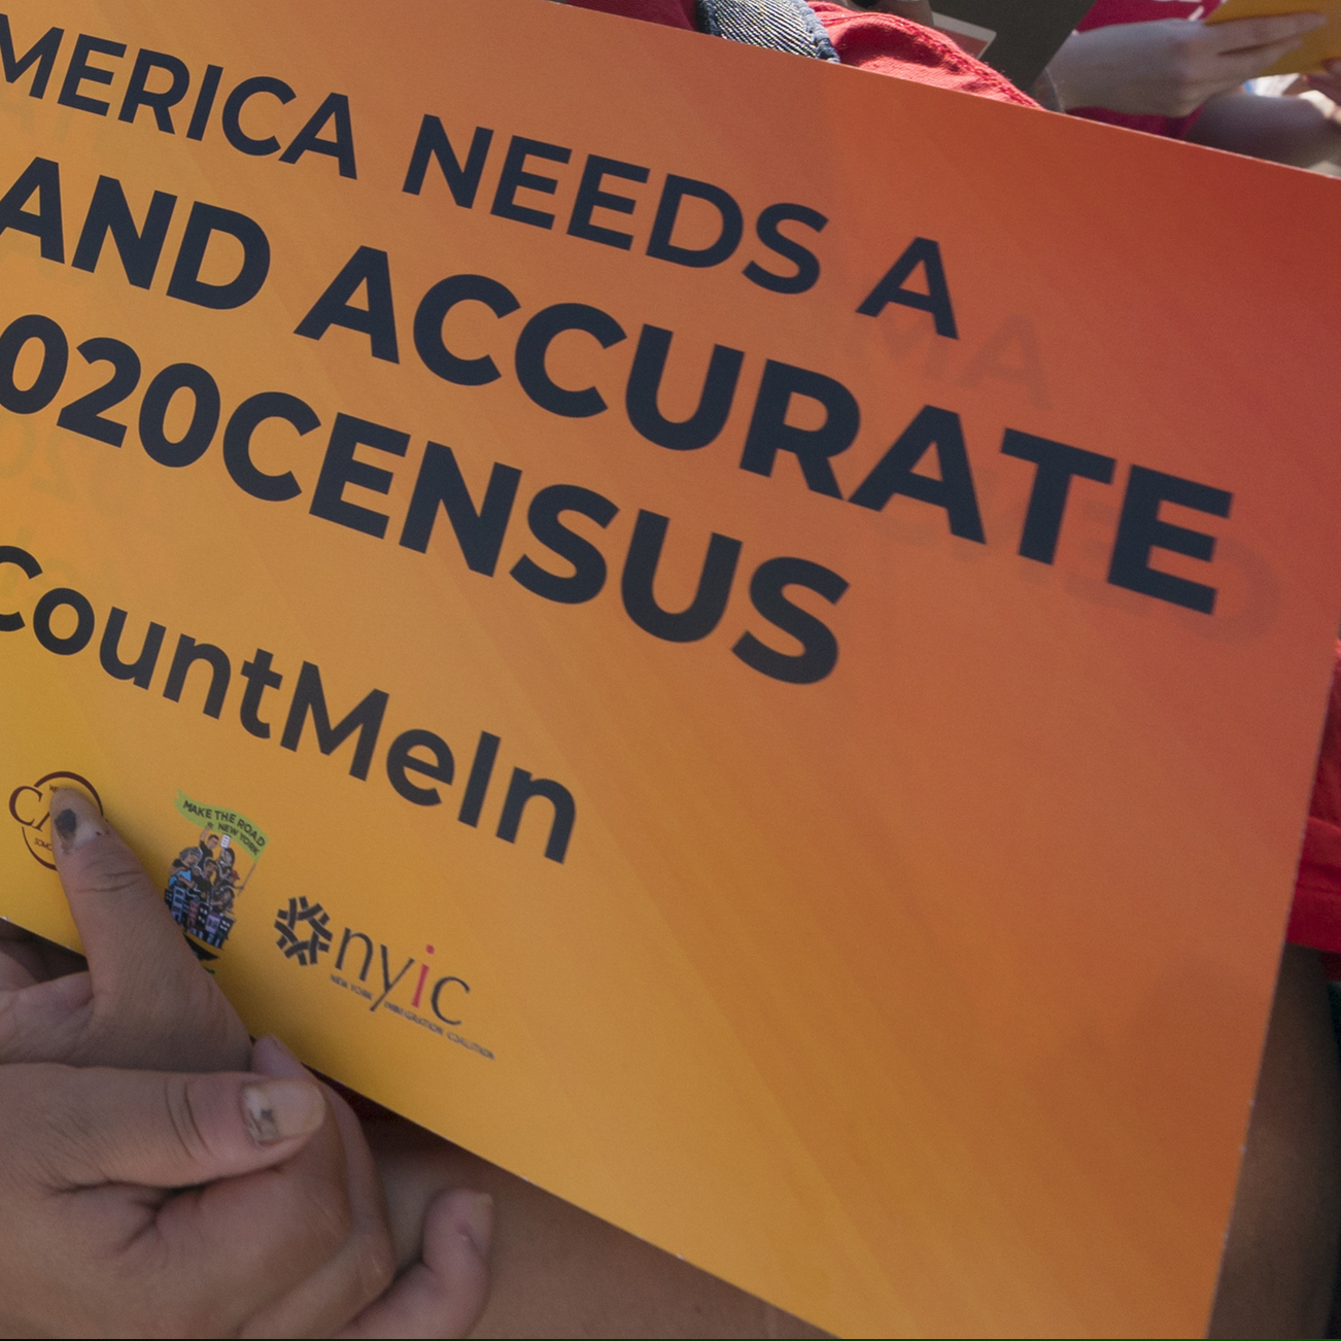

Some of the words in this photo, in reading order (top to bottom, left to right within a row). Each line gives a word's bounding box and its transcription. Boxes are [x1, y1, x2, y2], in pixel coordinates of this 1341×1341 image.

[401, 114, 830, 295] NEEDS
[854, 235, 960, 341] A
[292, 245, 1234, 616] ACCURATE
[183, 800, 213, 820] MAKE
[214, 809, 236, 824] THE
[236, 817, 266, 848] ROAD
[217, 822, 239, 837] NEW
[239, 830, 261, 857] YORK
[334, 926, 472, 1027] nyic
